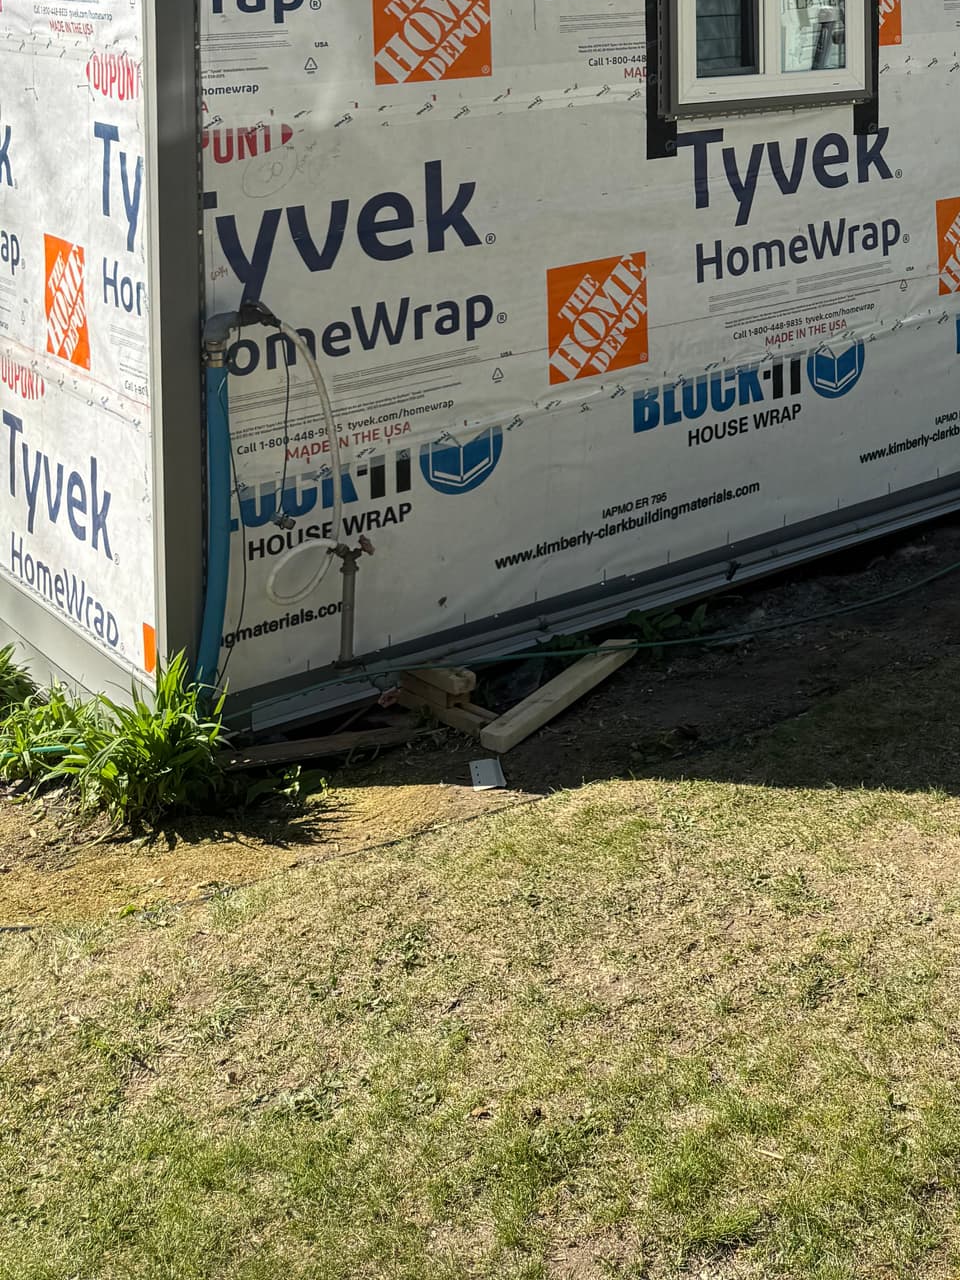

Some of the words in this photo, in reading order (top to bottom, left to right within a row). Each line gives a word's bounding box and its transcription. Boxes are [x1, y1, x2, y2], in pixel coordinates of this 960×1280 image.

[421, 1, 491, 81] DEPOT
[677, 125, 893, 227] Tyvek
[200, 160, 483, 304] yvek
[695, 217, 901, 283] HomeWrap
[548, 253, 649, 380] HOME
[556, 272, 600, 323] THE
[227, 293, 494, 376] omeWrap
[588, 293, 648, 375] DEPOT
[733, 330, 748, 340] Call
[765, 329, 794, 347] MADE
[796, 327, 806, 339] IN
[810, 323, 827, 336] THE
[829, 318, 848, 332] USA
[236, 442, 257, 455] Call
[285, 440, 331, 462] MADE
[352, 429, 380, 445] THE
[383, 421, 413, 437] USA
[687, 416, 748, 447] HOUSE
[753, 403, 802, 430] WRAP
[2, 409, 113, 561] Tyvek
[635, 497, 649, 510] ER
[651, 492, 667, 505] 795
[342, 502, 413, 538] WRAP
[11, 531, 120, 648] HomeWrap
